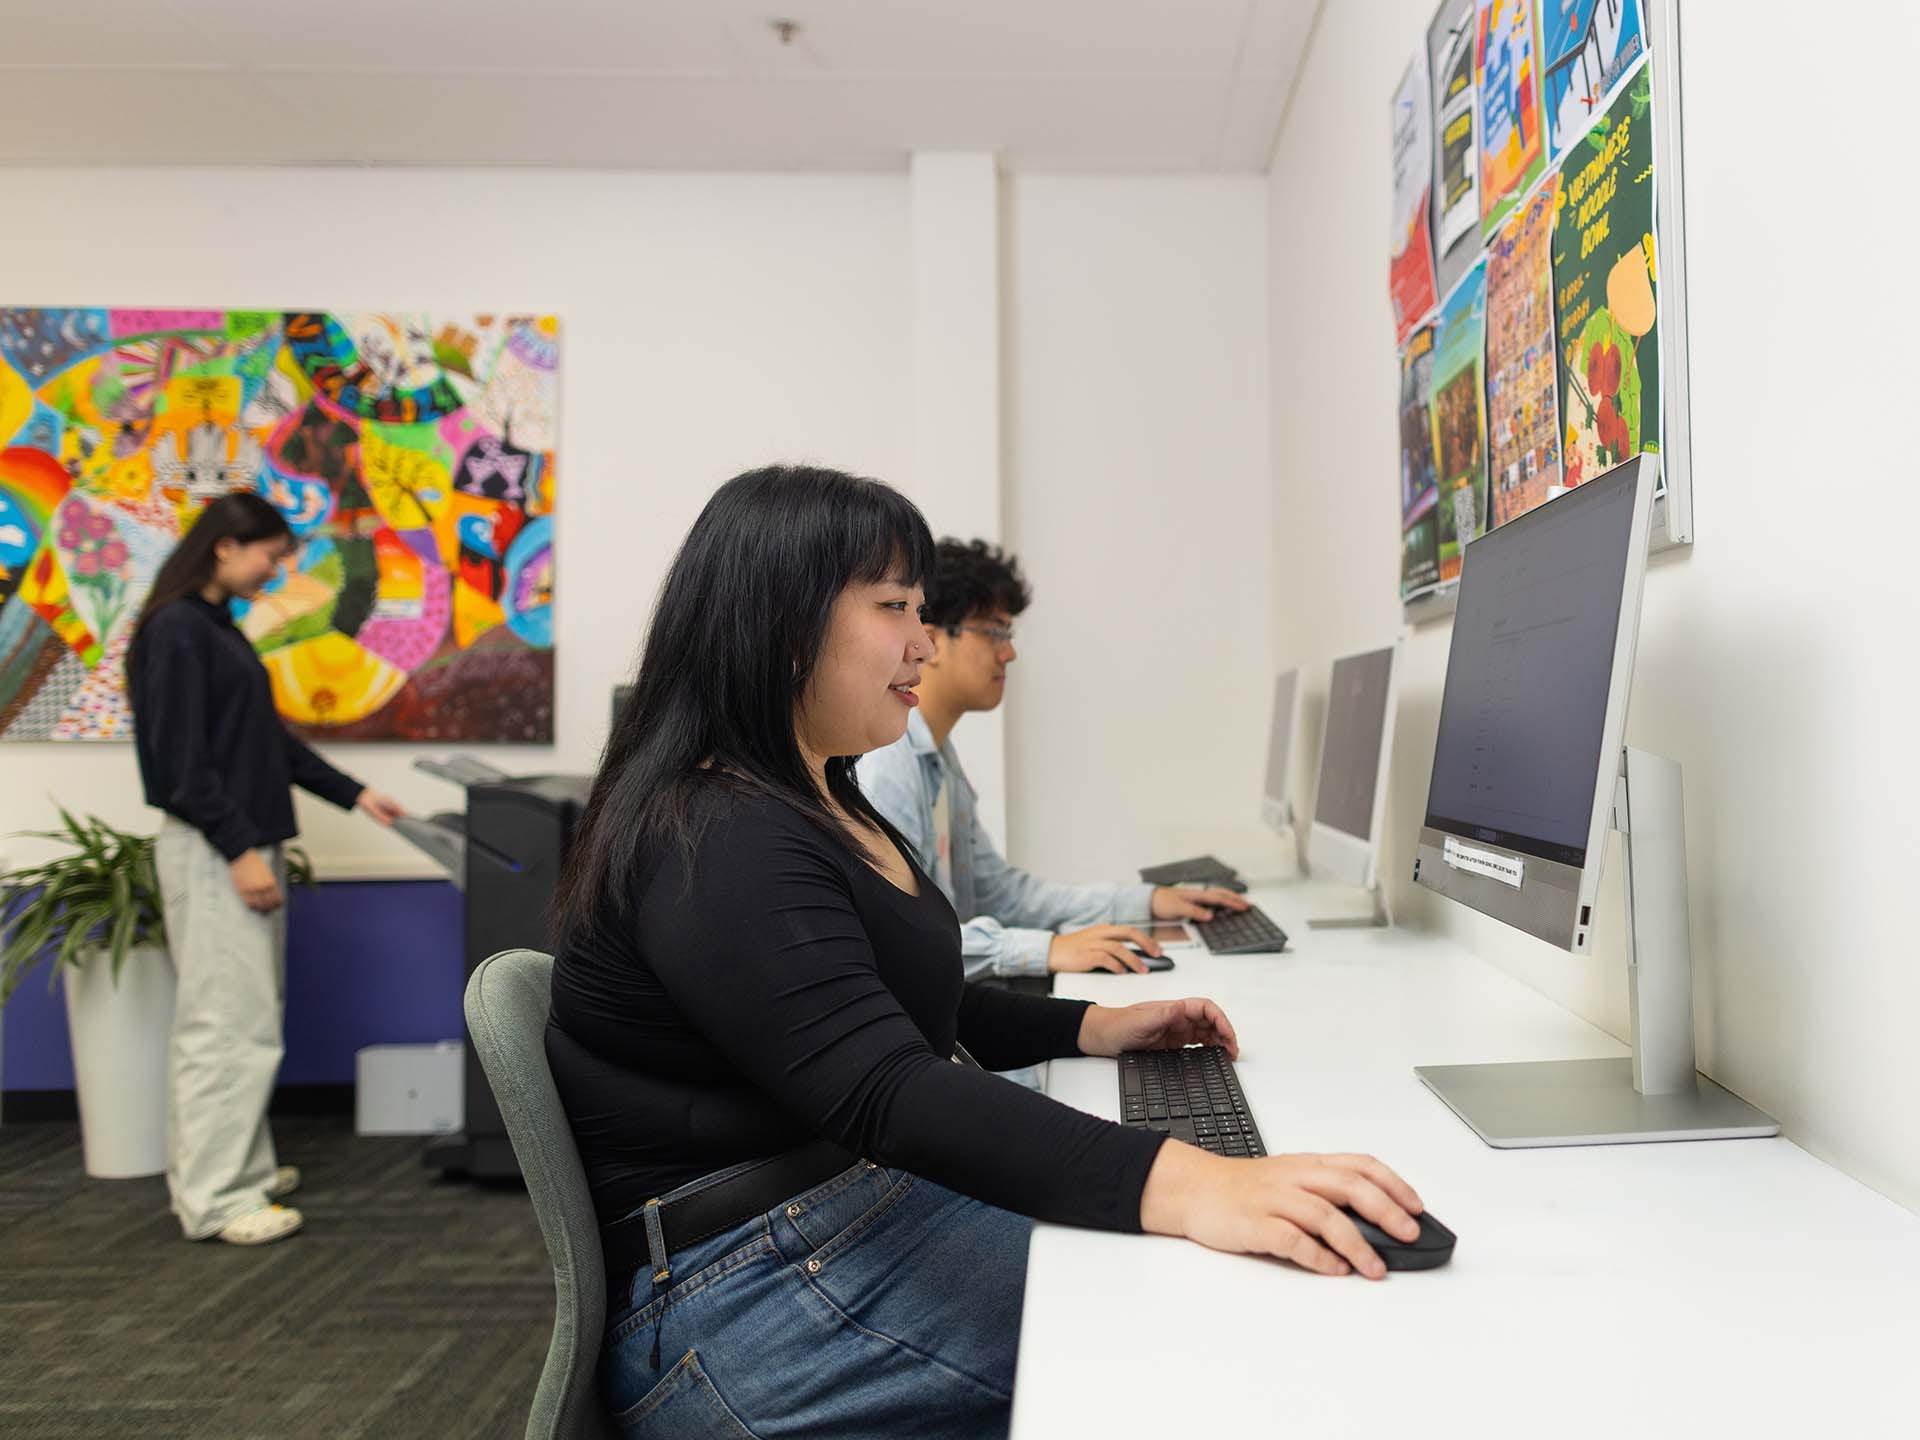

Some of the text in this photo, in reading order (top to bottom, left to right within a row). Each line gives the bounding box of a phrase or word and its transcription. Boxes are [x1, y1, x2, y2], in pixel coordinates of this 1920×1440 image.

[1568, 115, 1631, 207] VIETNAMESE
[1577, 166, 1618, 230] NOODLE
[1581, 211, 1610, 260] BOWL
